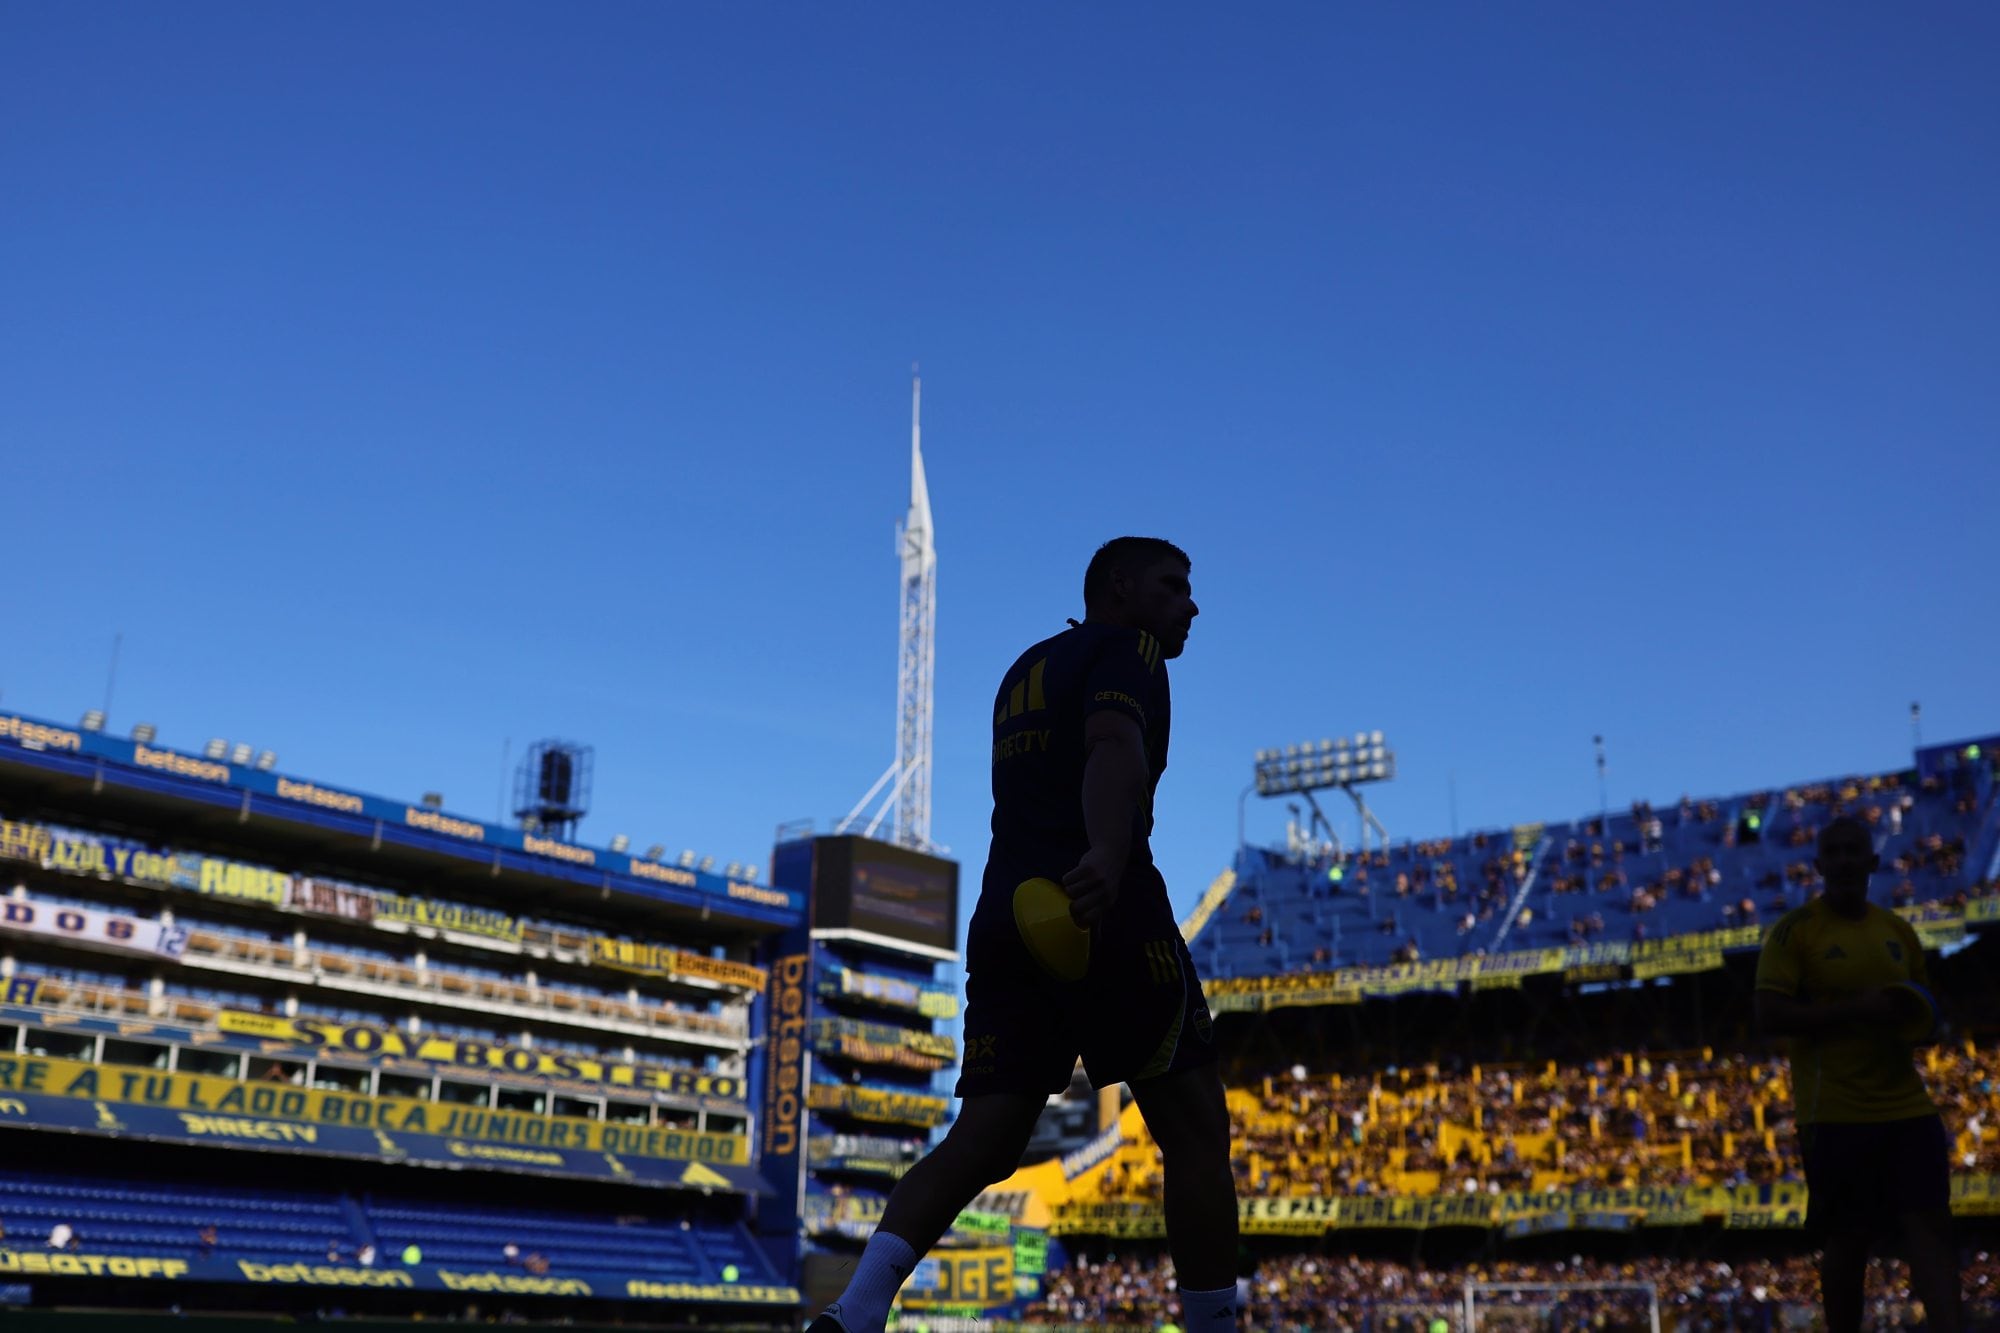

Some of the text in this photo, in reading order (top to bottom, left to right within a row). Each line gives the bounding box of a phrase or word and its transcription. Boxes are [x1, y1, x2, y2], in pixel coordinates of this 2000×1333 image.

[134, 743, 231, 785] betsson
[276, 776, 364, 814] betsson
[405, 807, 484, 842] betsson
[51, 839, 108, 874] AZUL
[523, 834, 596, 866] betsson
[629, 857, 697, 888] betsson
[728, 879, 790, 907] betsson
[293, 1017, 741, 1099] SOY BOSTERO
[775, 953, 810, 1155] betsson
[67, 1069, 99, 1098] A
[120, 1073, 172, 1103] TU
[189, 1082, 308, 1117] LADO
[321, 1096, 426, 1130] BOCA
[434, 1106, 591, 1149] JUNIORS
[601, 1126, 736, 1162] QUERIDO
[178, 1112, 318, 1144] DIRECTV
[237, 1259, 414, 1288] betsson
[438, 1268, 593, 1297] betsson
